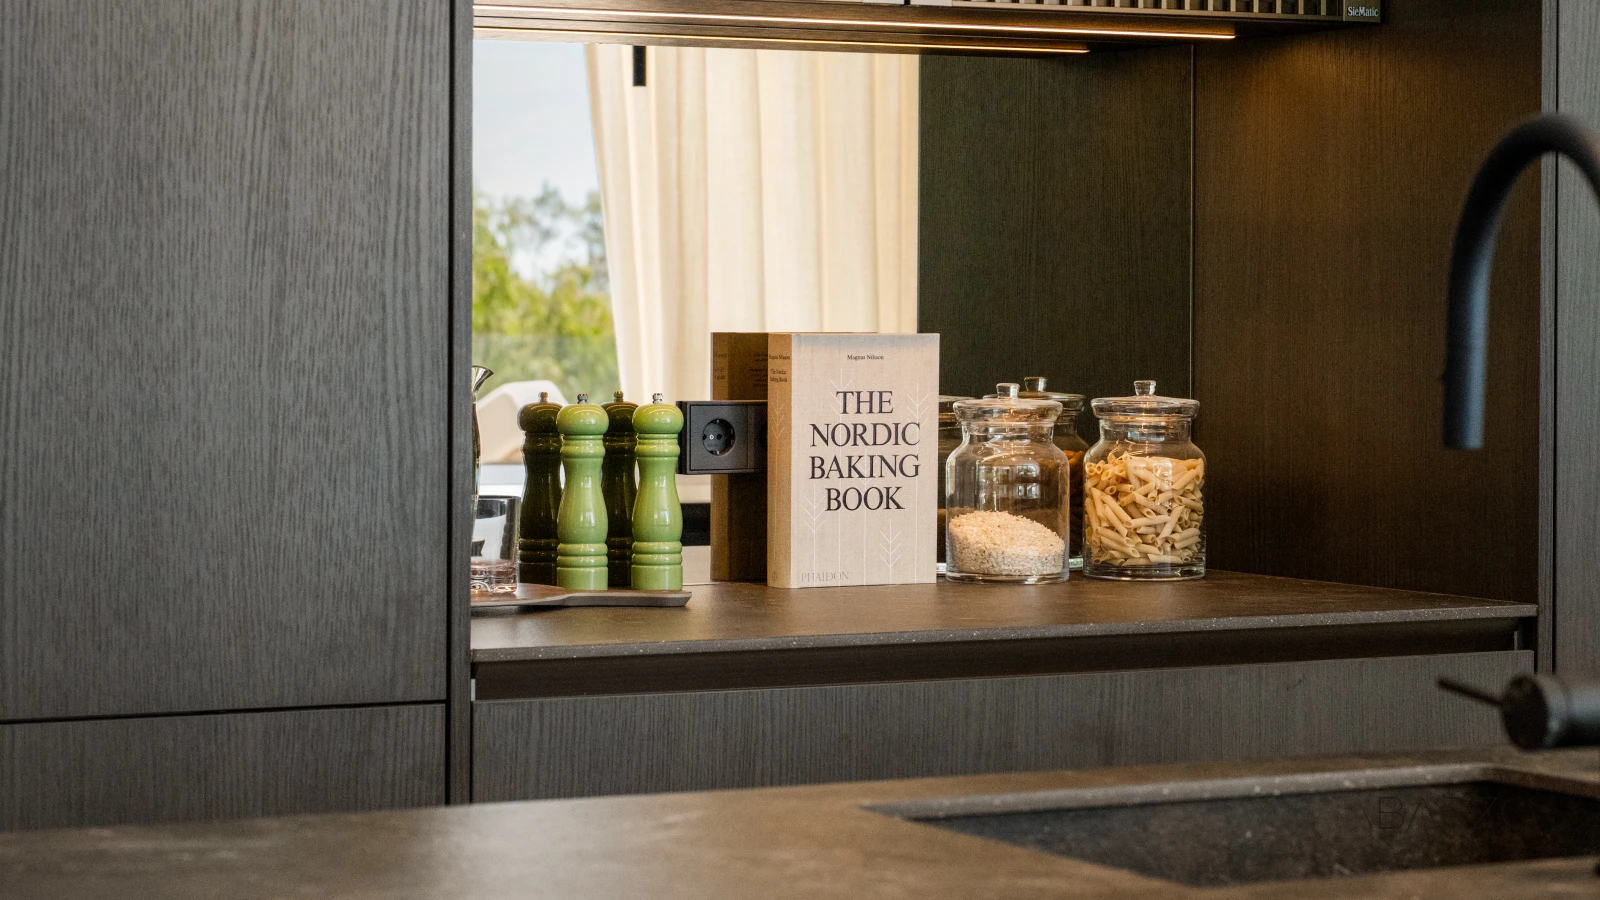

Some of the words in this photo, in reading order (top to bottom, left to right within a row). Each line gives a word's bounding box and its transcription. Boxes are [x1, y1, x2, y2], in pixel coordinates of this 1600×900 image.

[1347, 6, 1379, 17] SieMatic
[836, 390, 894, 414] THE
[809, 422, 921, 447] NORDIC
[809, 454, 921, 479] BAKING
[825, 486, 905, 511] BOOK
[801, 571, 849, 582] PHAIDON
